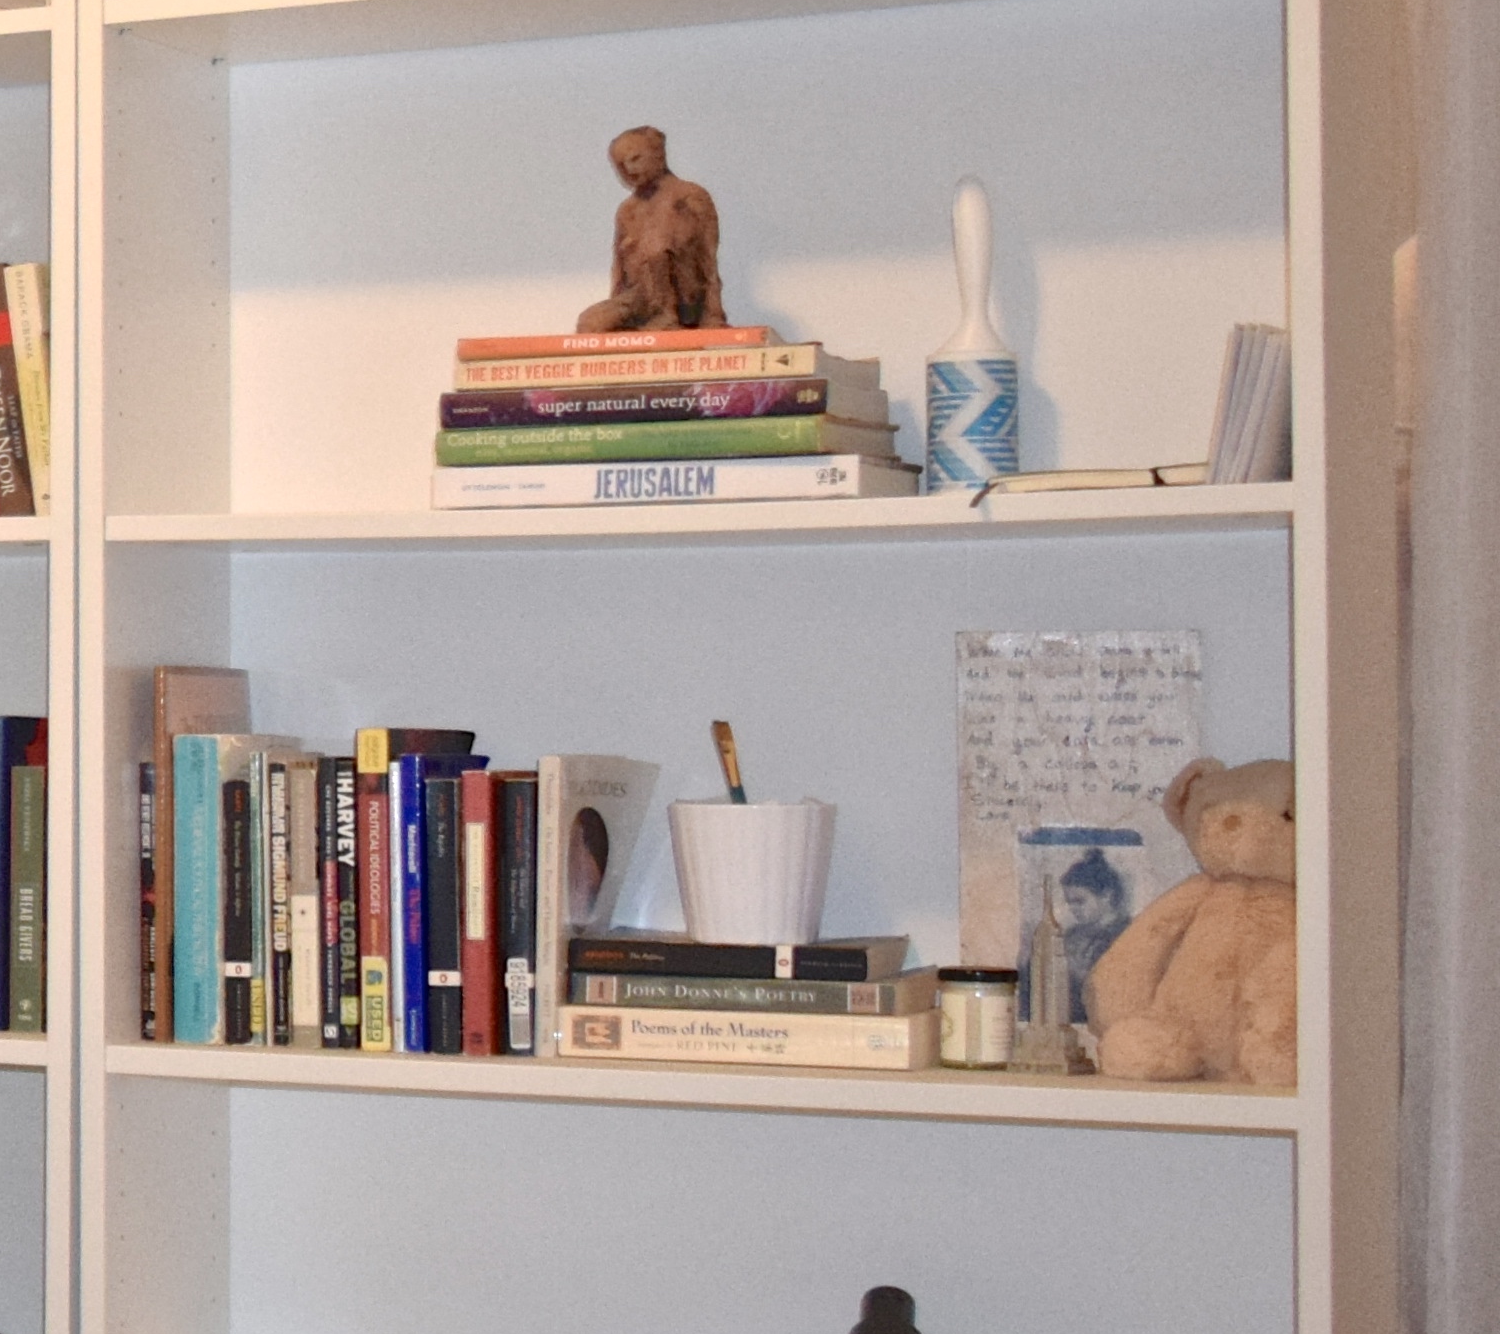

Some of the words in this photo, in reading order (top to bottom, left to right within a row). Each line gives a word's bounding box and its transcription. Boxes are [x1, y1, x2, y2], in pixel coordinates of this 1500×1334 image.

[14, 270, 28, 314] BARACK
[21, 319, 34, 359] OBAMA
[563, 337, 600, 349] FIND
[605, 335, 656, 348] MOMO
[465, 368, 485, 382] THE
[491, 366, 519, 381] BEST
[524, 364, 576, 380] VEGGIE
[579, 360, 647, 378] BURGERS
[651, 360, 670, 375] ON
[674, 359, 694, 373] THE
[698, 355, 748, 372] PLANET
[537, 400, 581, 417] super
[586, 396, 646, 411] natural
[650, 394, 698, 413] every
[701, 392, 731, 411] day
[447, 431, 507, 448] Cooking
[512, 428, 565, 445] outside
[568, 428, 592, 442] the
[596, 427, 623, 441] box
[593, 465, 716, 500] JERUSALEM
[336, 777, 356, 867] HARVEY
[368, 800, 382, 851] POLITICAL
[271, 835, 287, 902] SIGMUND
[407, 824, 418, 873] Machiavelli
[368, 853, 382, 914] IDEOLOGIES
[19, 888, 33, 921] BREAD
[18, 926, 33, 962] GIVERS
[273, 905, 288, 952] FREUD
[340, 900, 356, 984] GLOBAL
[624, 982, 666, 1000] JOHN
[674, 983, 746, 1000] DONNE'S
[754, 986, 817, 1003] POETRY
[372, 996, 384, 1043] USED
[631, 1019, 677, 1035] Poems
[681, 1020, 698, 1035] of
[700, 1021, 722, 1036] the
[726, 1022, 789, 1038] Masters
